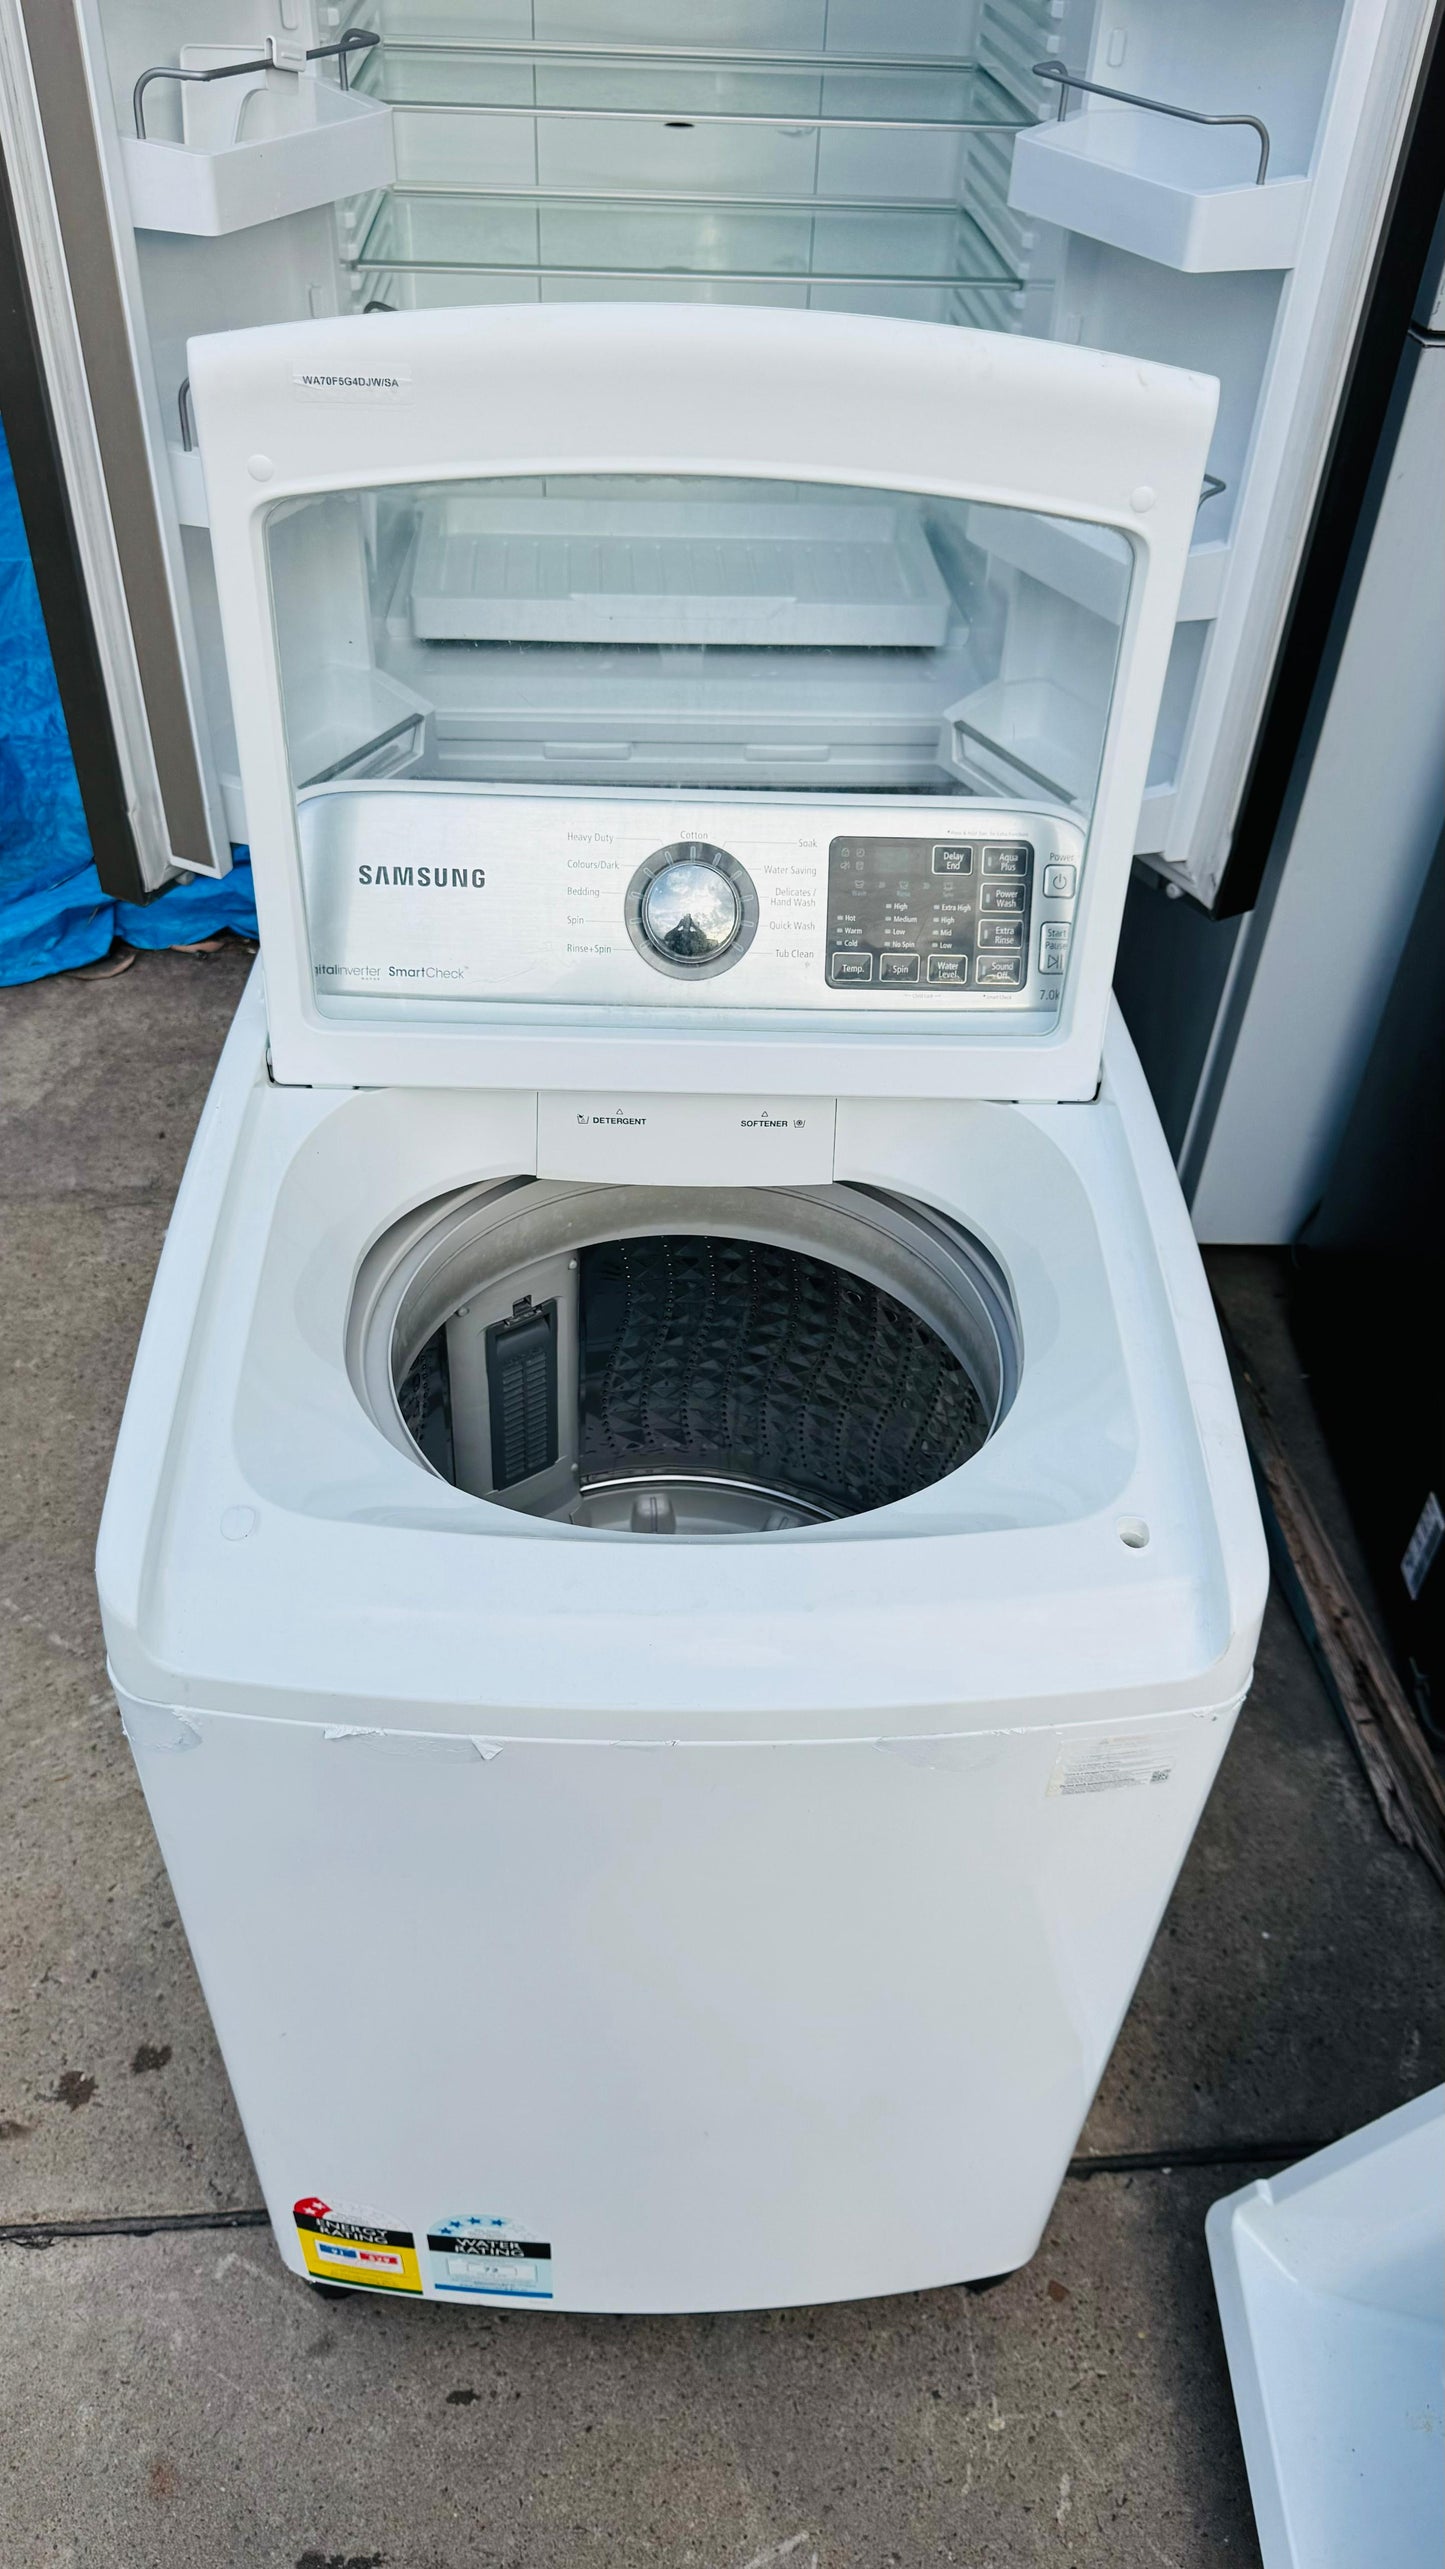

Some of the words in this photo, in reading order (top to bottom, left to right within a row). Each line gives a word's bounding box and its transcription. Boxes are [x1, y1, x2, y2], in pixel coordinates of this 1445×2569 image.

[302, 375, 399, 387] WA70F5G4DJW/SA
[567, 832, 592, 843] Heavy
[594, 833, 614, 843] Duty
[680, 831, 709, 840] Cotton
[799, 839, 818, 848] Soak
[943, 851, 965, 862] Delay
[999, 853, 1019, 862] Aqua
[1049, 852, 1075, 861] Power
[567, 860, 620, 870] Colours/Dark
[946, 861, 961, 870] End
[1000, 862, 1016, 872] Plus
[763, 865, 789, 875] Water
[790, 866, 817, 877] Saving
[358, 864, 486, 889] SAMSUNG
[567, 887, 600, 898] Bedding
[775, 887, 811, 897] Delicates
[995, 889, 1018, 898] Power
[770, 898, 792, 907] Hand
[794, 898, 816, 907] Wash
[996, 899, 1017, 908] Wash
[893, 903, 908, 912] High
[957, 904, 972, 913] High
[567, 915, 584, 926] Spin
[844, 914, 856, 922] Hot
[893, 915, 918, 923] Medium
[940, 916, 955, 925] High
[769, 921, 792, 930] Quick
[793, 921, 816, 931] Wash
[995, 926, 1015, 935] Extra
[844, 927, 863, 935] Warm
[892, 928, 906, 936] Low
[1047, 928, 1067, 938] Start
[994, 936, 1015, 945] Rinse
[566, 944, 612, 954] Rinse+Spin
[903, 941, 916, 950] Spin
[775, 949, 789, 958] Tub
[791, 949, 815, 958] Clean
[842, 964, 865, 974] Temp.
[892, 965, 909, 975] Spin
[938, 961, 959, 970] Water
[991, 962, 1014, 971] Sound
[388, 965, 465, 979] SmartCheck
[592, 1116, 647, 1126] DETERGENT
[740, 1119, 789, 1128] SOFTENER
[315, 2217, 388, 2237] ENERGY
[319, 2226, 388, 2245] RATING
[455, 2238, 521, 2250] WATER
[454, 2244, 525, 2257] RATING
